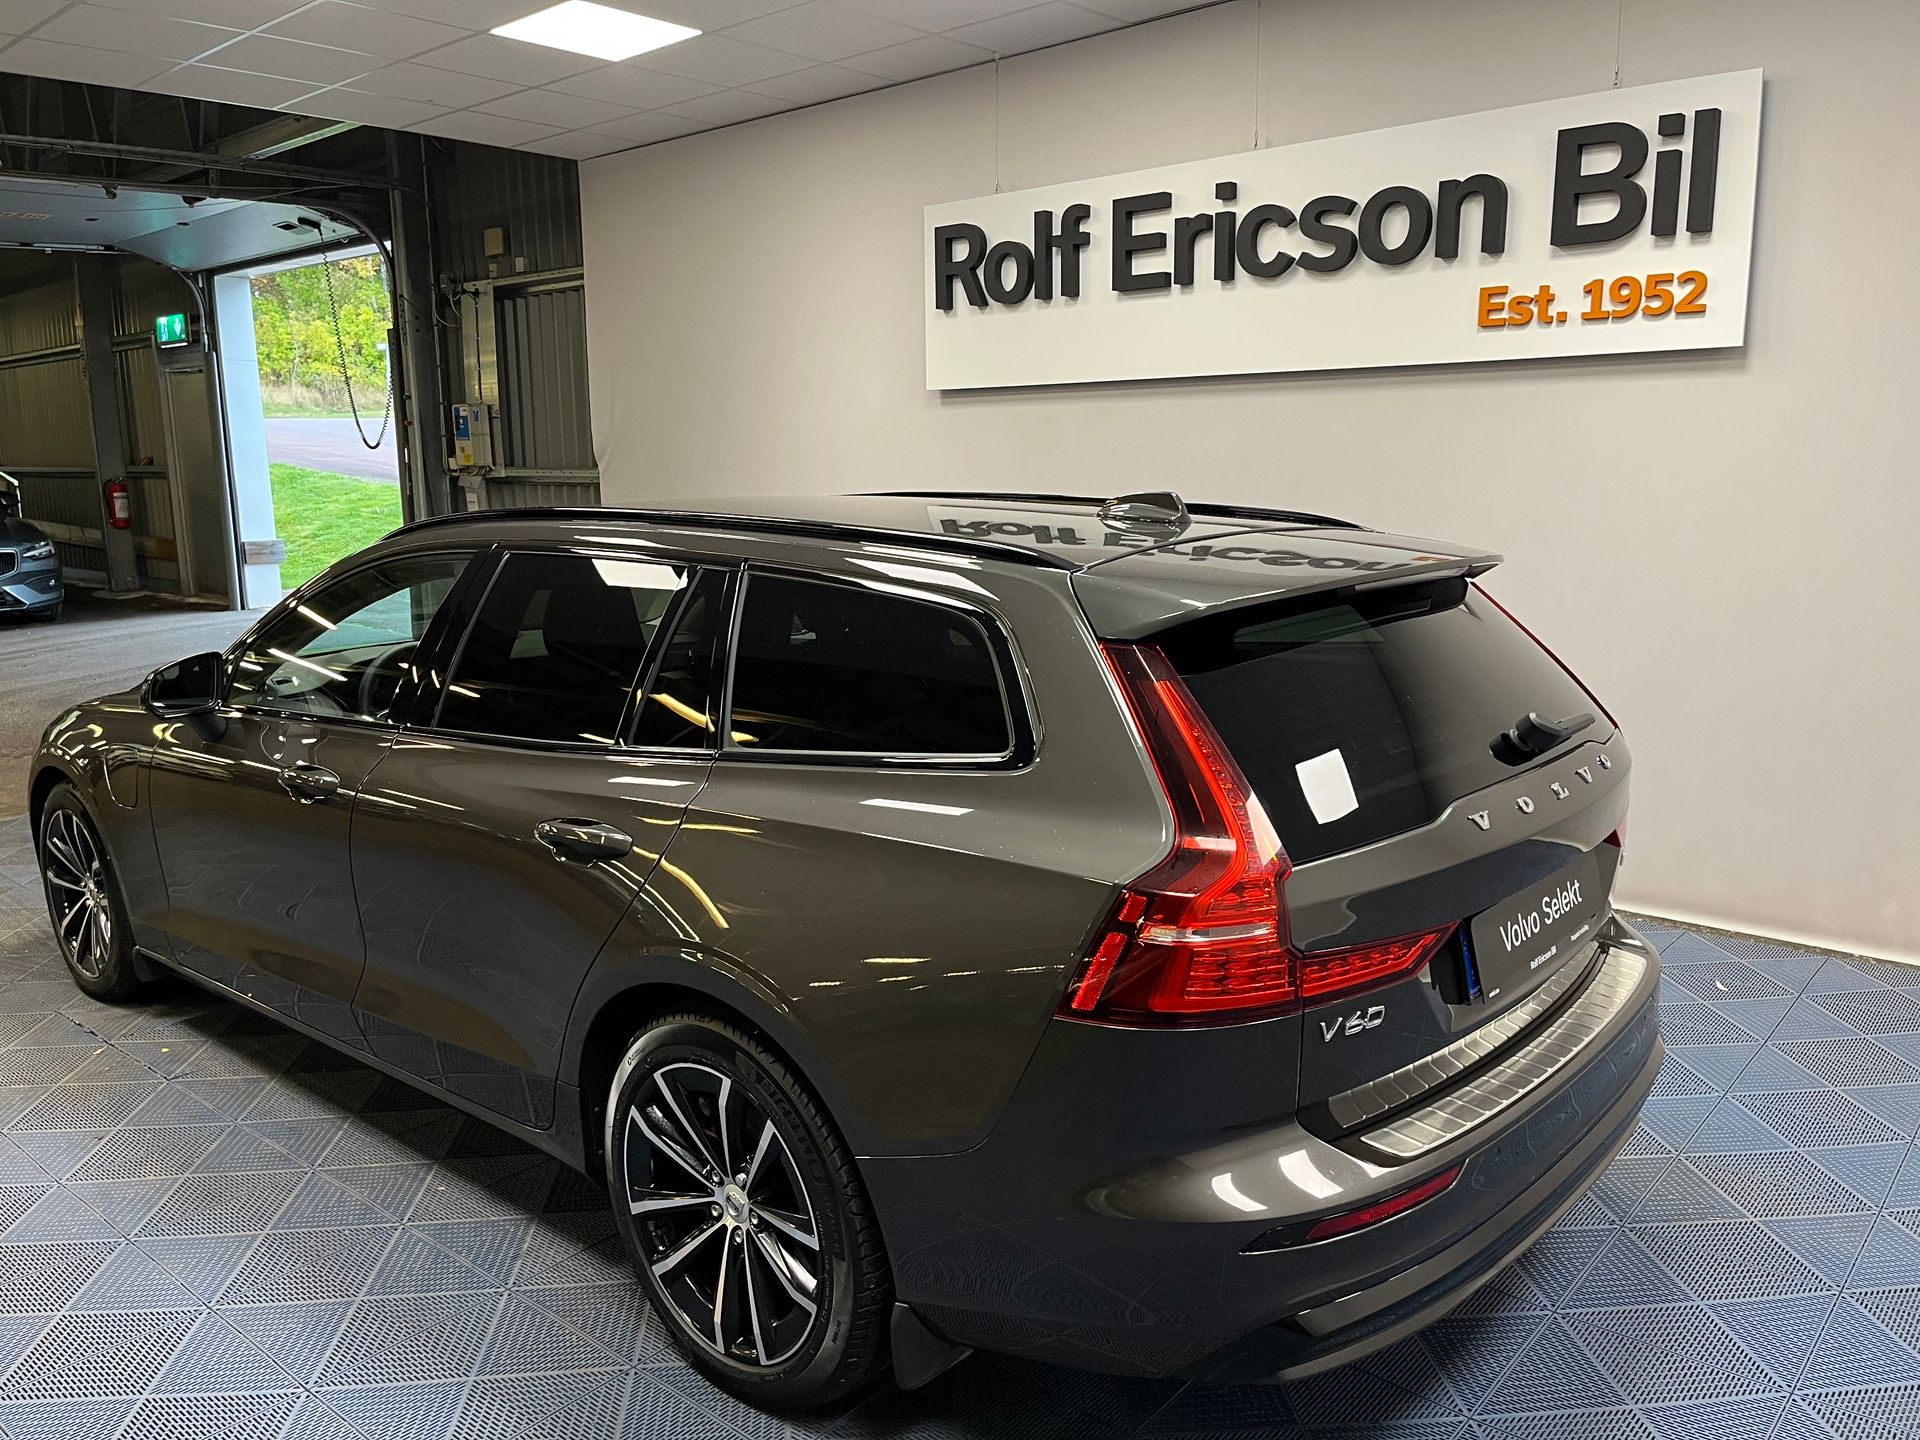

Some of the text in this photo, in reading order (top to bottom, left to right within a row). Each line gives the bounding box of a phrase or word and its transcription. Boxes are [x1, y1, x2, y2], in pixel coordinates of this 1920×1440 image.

[934, 108, 1722, 313] Rolf Ericson Bil
[1477, 270, 1709, 329] Est. 1952
[1467, 753, 1612, 831] VOLVO
[1499, 880, 1582, 952] Volvo Selekt
[1319, 1005, 1386, 1043] V60
